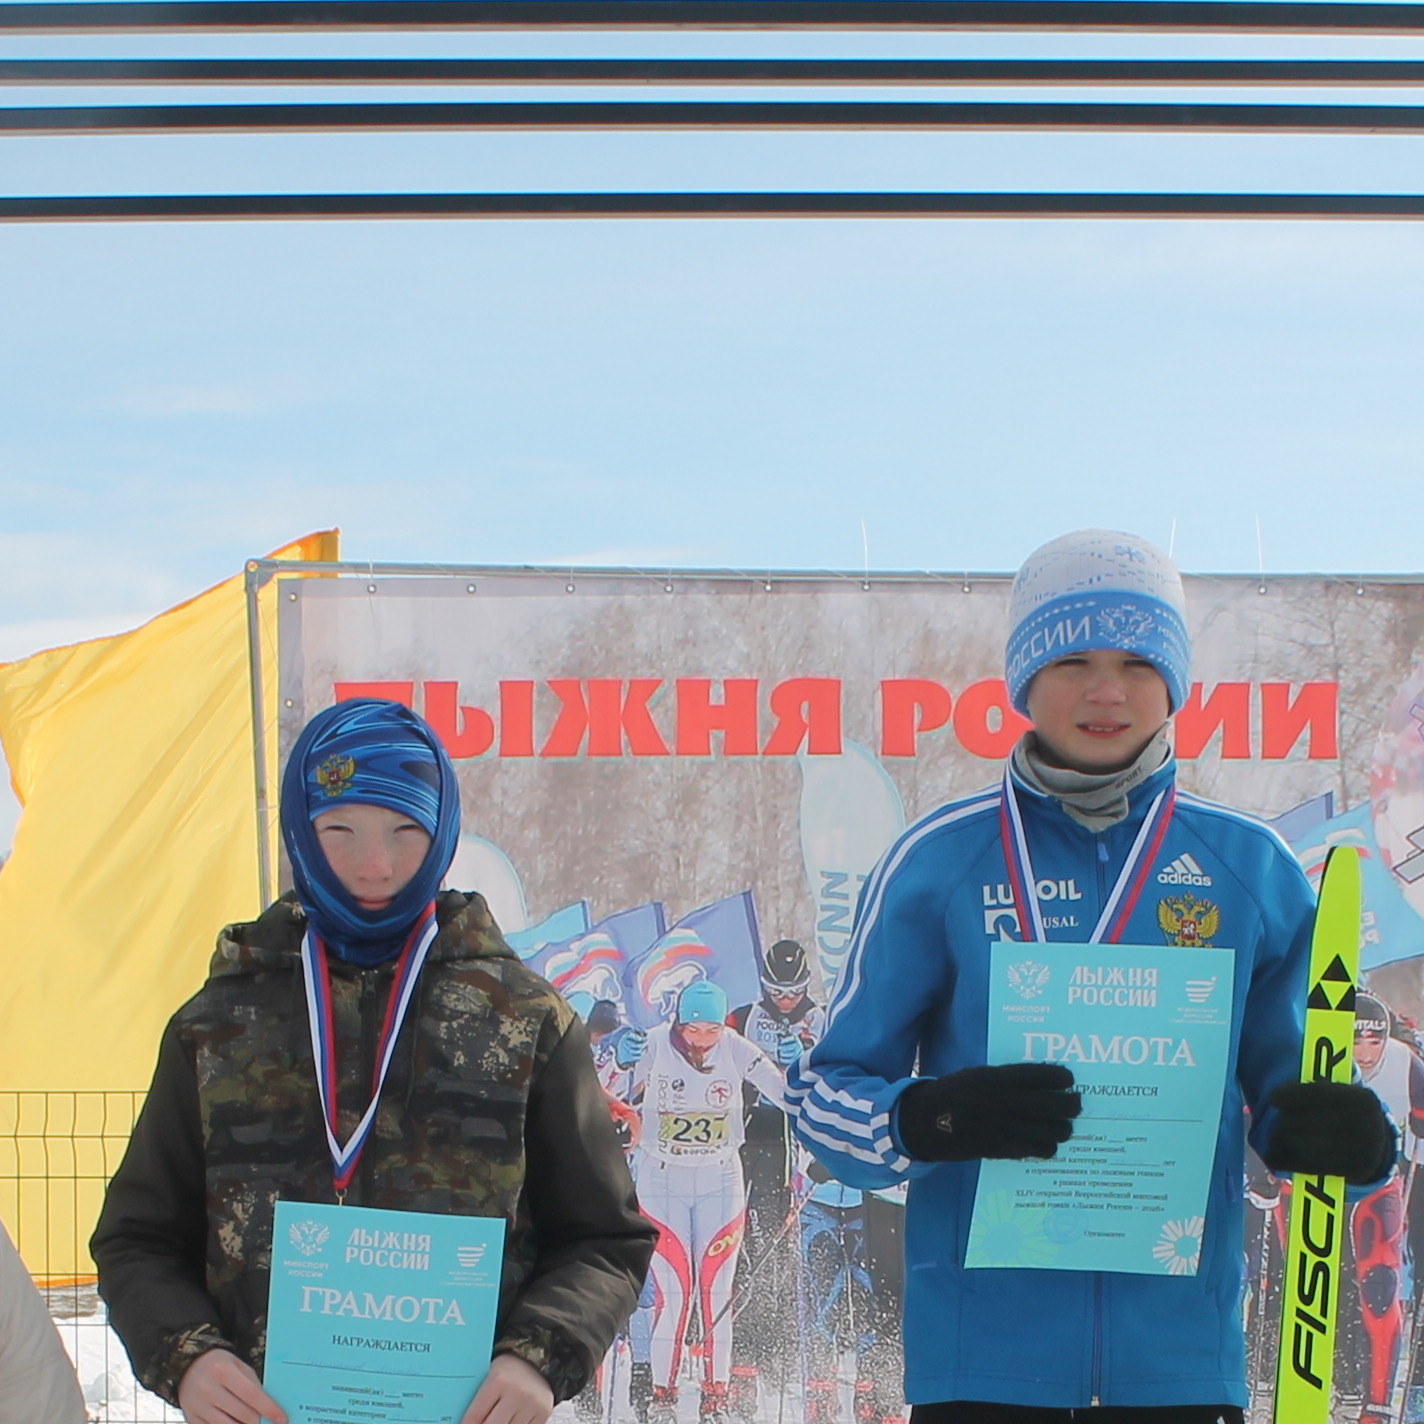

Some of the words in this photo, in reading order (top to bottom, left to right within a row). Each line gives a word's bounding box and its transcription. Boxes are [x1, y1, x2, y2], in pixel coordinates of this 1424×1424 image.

[333, 678, 842, 758] ЫЖНЯ
[880, 679, 1339, 759] РОИИ
[1157, 872, 1212, 887] adidas
[982, 879, 1082, 906] LUOIL
[1041, 915, 1079, 930] USAL
[1069, 966, 1159, 987] ЛЫЖНЯ
[1068, 987, 1157, 1007] РОССИИ
[1022, 1033, 1196, 1066] ГРАМОТА
[1071, 1084, 1158, 1096] ГРАЖДАЕТСЯ
[348, 1228, 431, 1252] ЛЫЖНЯ
[346, 1248, 429, 1271] РОССИИ
[300, 1286, 466, 1325] ГРАМОТА
[332, 1335, 431, 1353] НАГРАЖДАЕТСЯ
